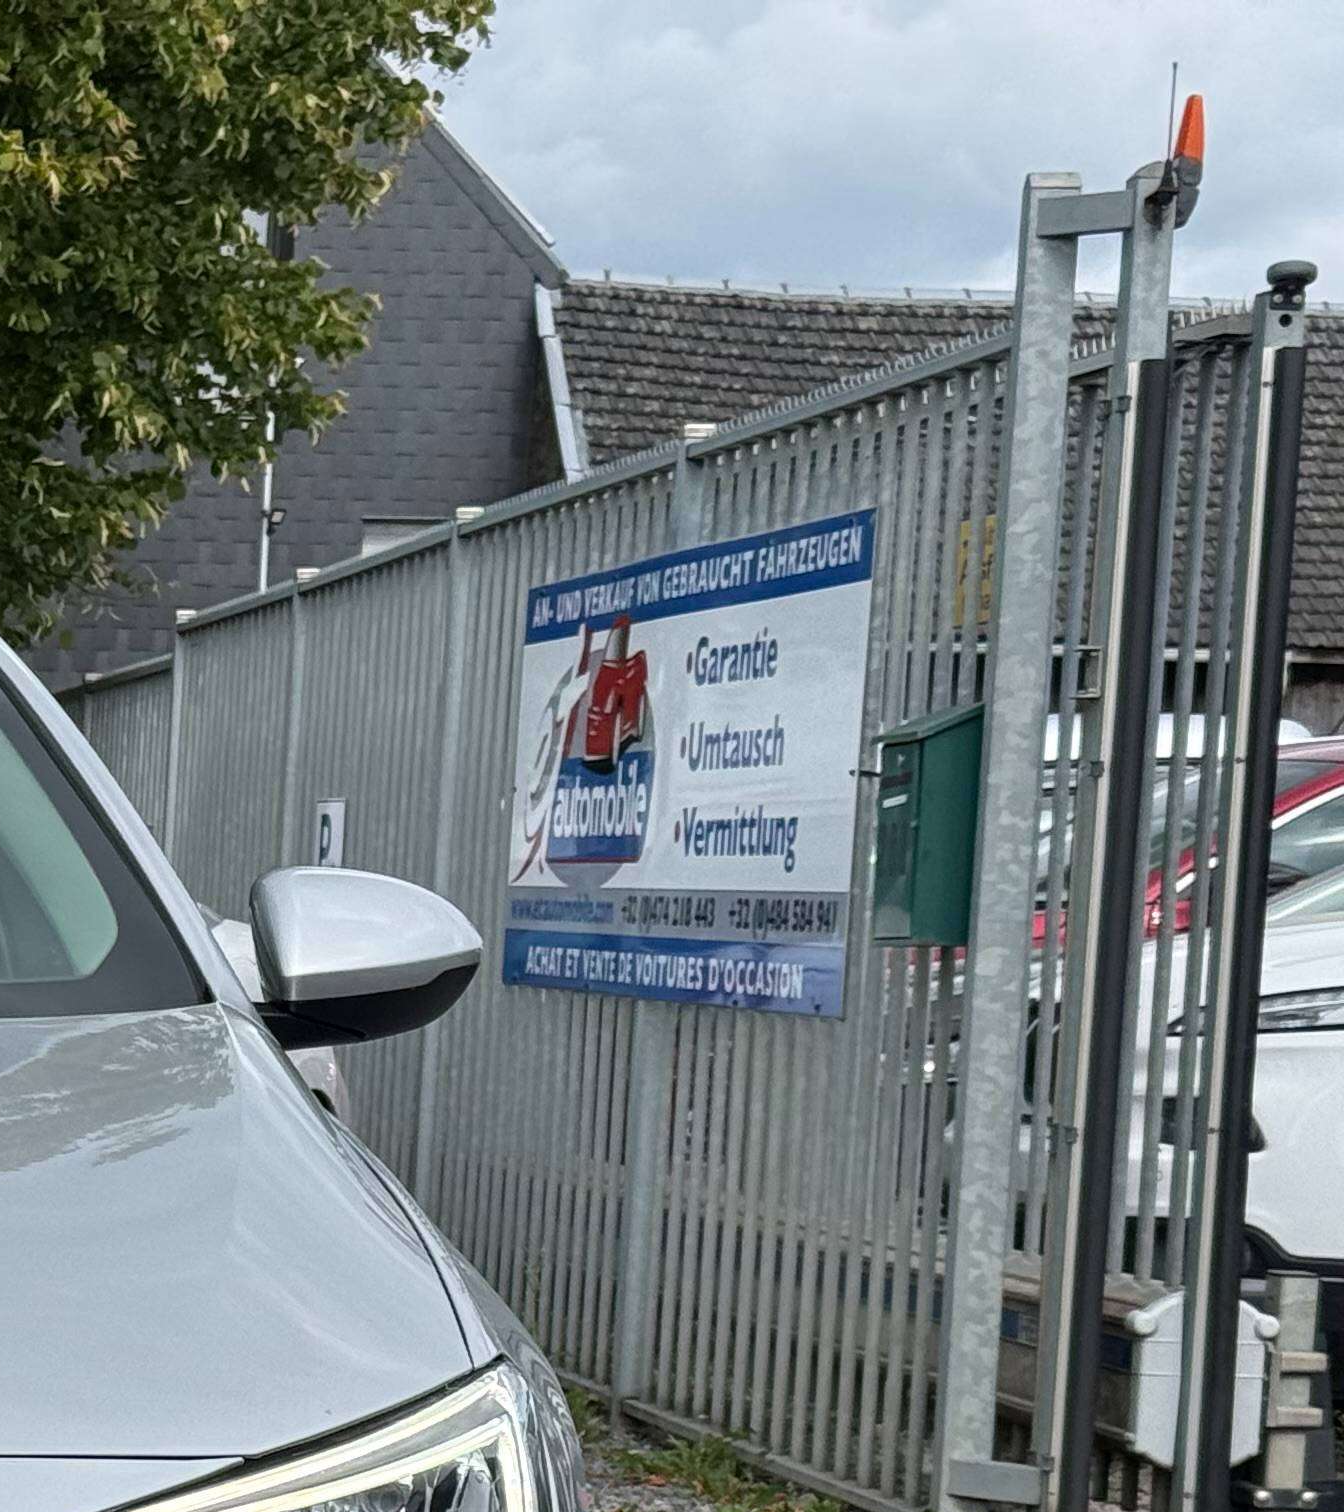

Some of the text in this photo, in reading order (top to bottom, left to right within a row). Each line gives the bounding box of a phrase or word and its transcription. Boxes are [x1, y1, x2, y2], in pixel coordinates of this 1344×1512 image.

[532, 525, 864, 630] AN- UND VERKAUF VON GEBRAUCHT FAHRZEUGEN
[693, 627, 779, 687] Garantie
[688, 714, 785, 772] Umtausch
[553, 760, 647, 838] automobile
[682, 804, 799, 874] Vermittlung
[524, 945, 804, 1000] ACHAT ET VENTE DE VOITURES D'OCCASION
